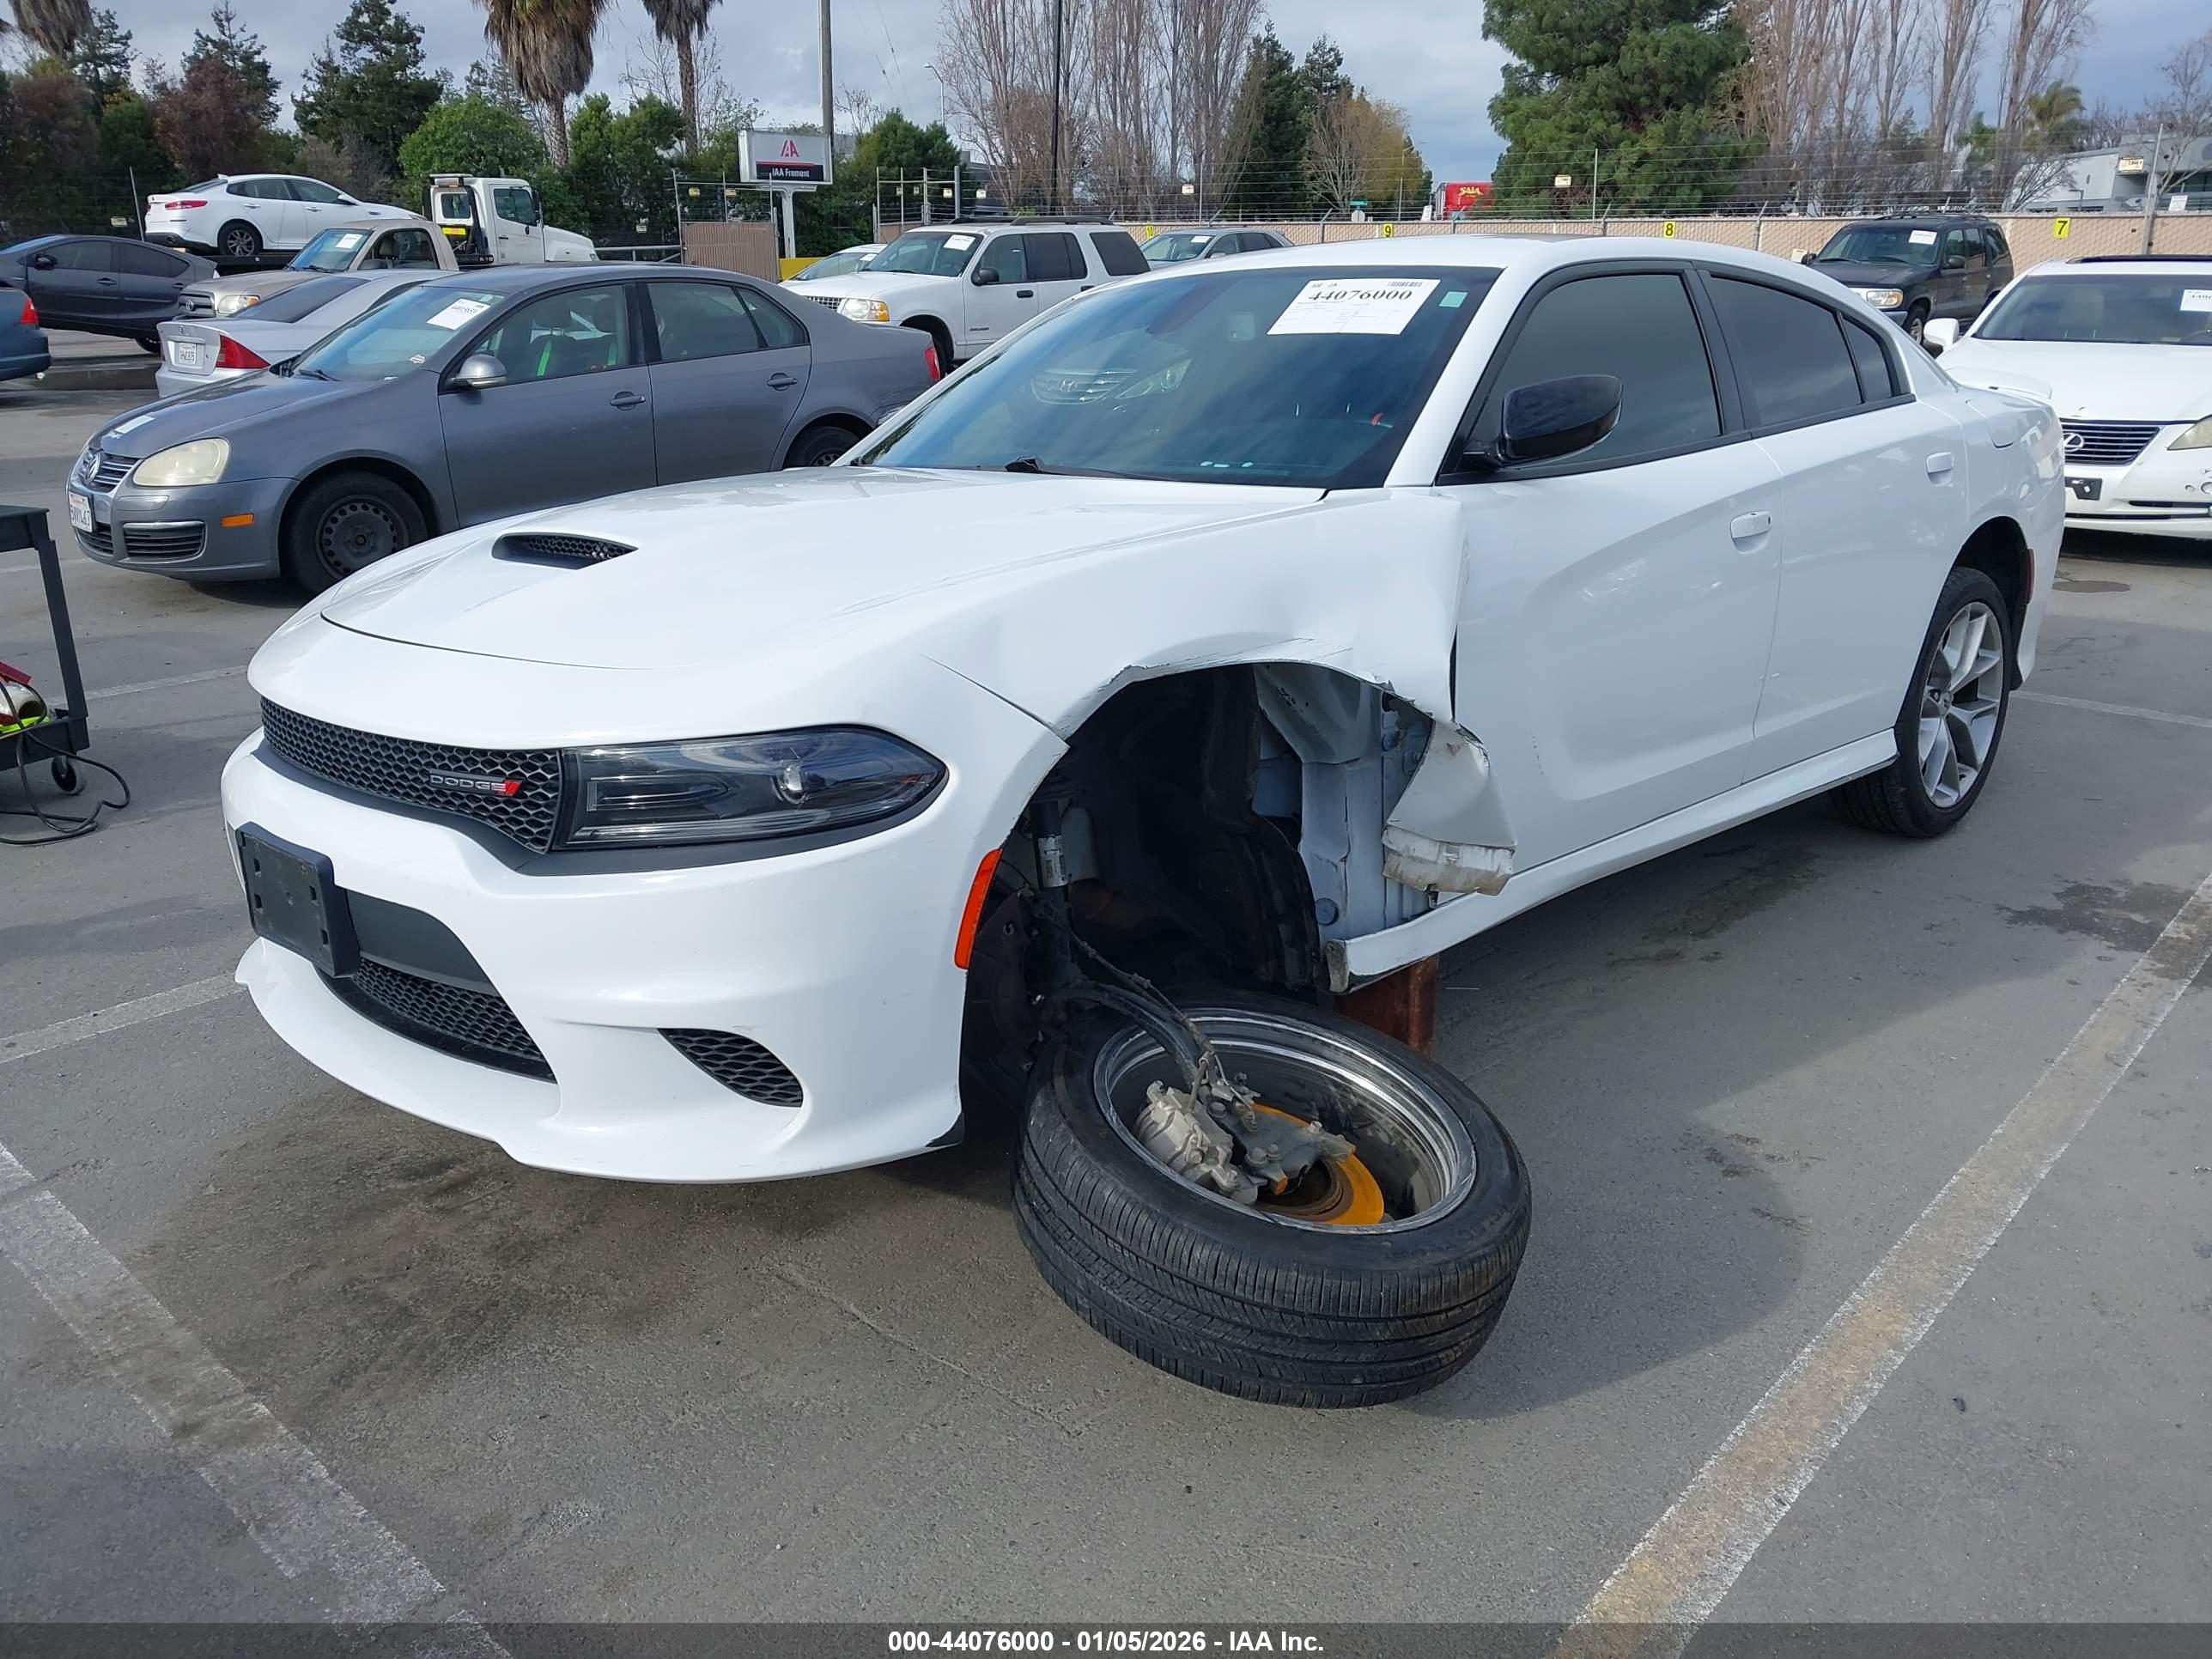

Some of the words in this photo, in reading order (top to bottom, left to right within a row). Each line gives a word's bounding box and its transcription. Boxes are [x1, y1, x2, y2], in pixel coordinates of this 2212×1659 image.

[772, 167, 784, 177] IAA
[785, 167, 810, 179] Fremont
[1458, 185, 1484, 197] SAIA
[1384, 225, 1392, 238] 9
[1665, 222, 1674, 237] 8
[2057, 220, 2069, 235] 7
[1308, 289, 1413, 301] 44076000
[429, 775, 507, 793] DODGE
